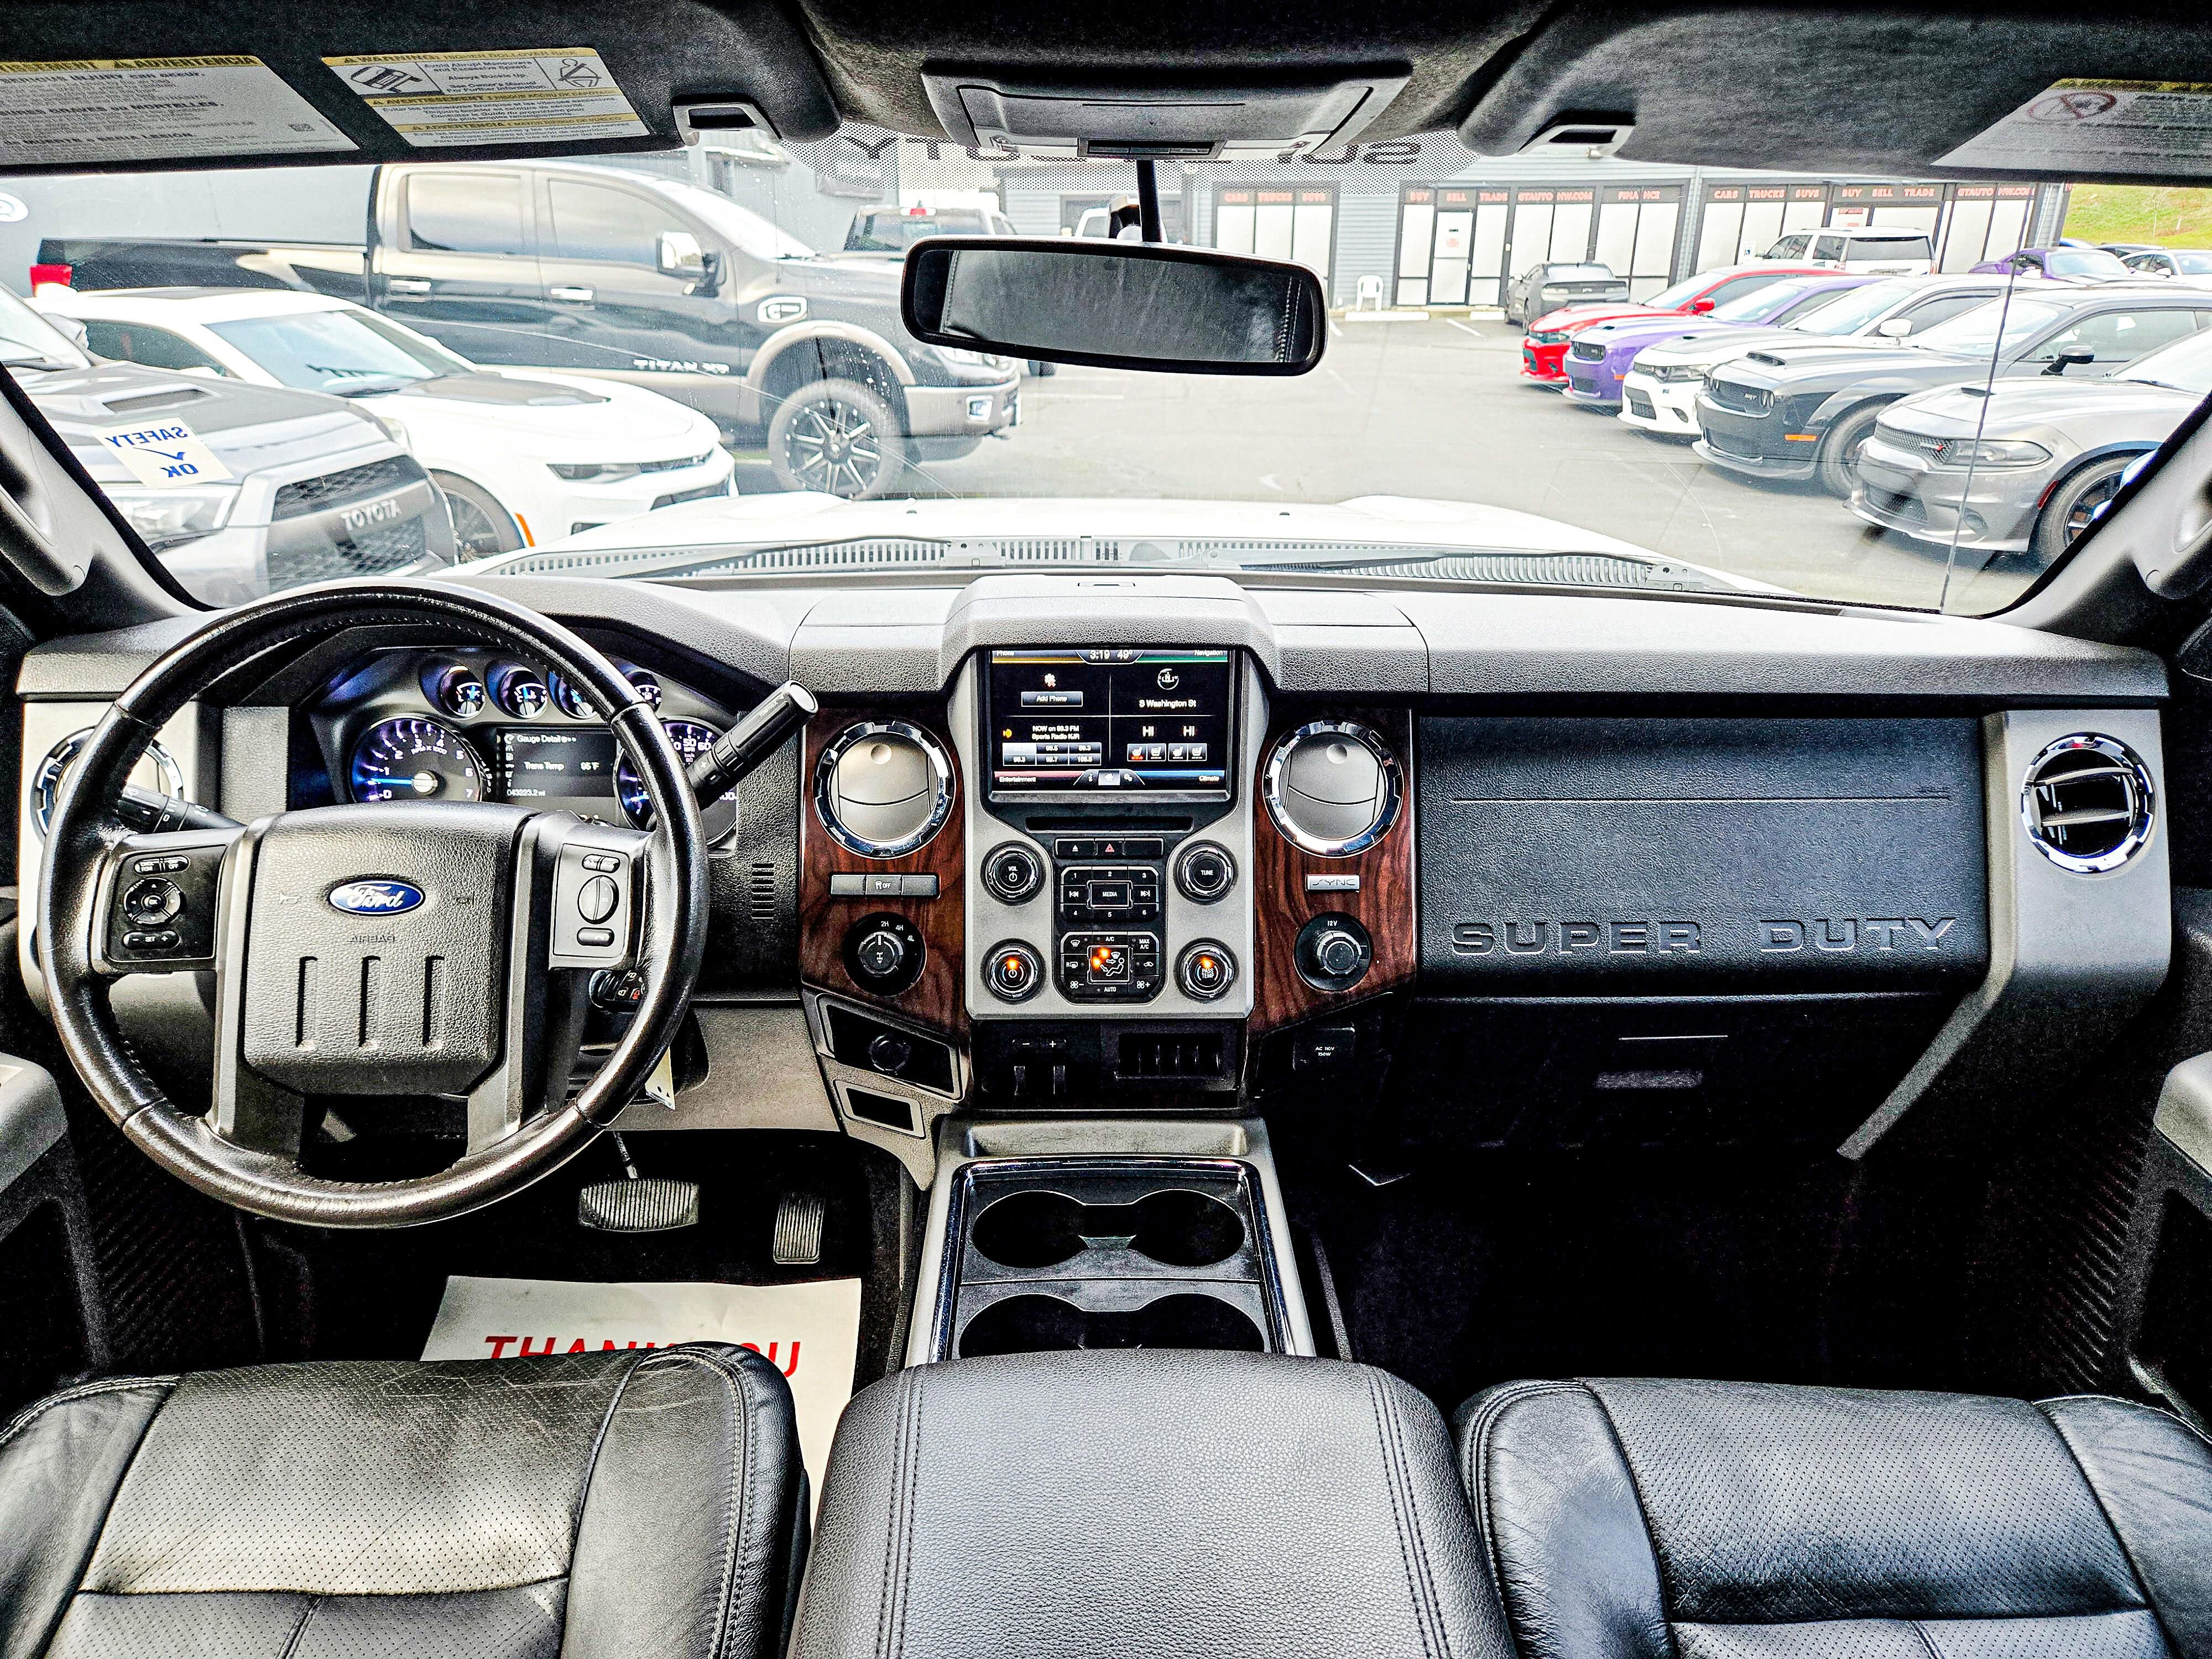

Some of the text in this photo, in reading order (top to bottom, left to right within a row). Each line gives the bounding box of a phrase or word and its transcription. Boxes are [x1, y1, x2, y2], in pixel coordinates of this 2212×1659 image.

[1410, 191, 1430, 201] BUY
[1446, 192, 1467, 202] SELL
[1479, 191, 1509, 202] TRADE
[1714, 190, 1738, 199] CARS
[1749, 189, 1786, 199] TRUCKS
[1795, 189, 1820, 198] SUVS
[1841, 188, 1863, 197] BUY
[1871, 188, 1893, 197] SELL
[1904, 188, 1935, 197] TRADE
[633, 359, 698, 372] TITAN
[340, 499, 403, 531] TOYOTA
[1089, 649, 1110, 660] 3:19
[1139, 699, 1197, 709] S Washington St
[1142, 726, 1155, 737] HI
[1183, 726, 1195, 737] HI
[517, 734, 541, 744] Gauge
[683, 738, 697, 747] 50
[697, 742, 712, 751] 60
[394, 750, 404, 760] 2
[456, 750, 465, 760] 5
[524, 761, 544, 770] Trans
[544, 761, 565, 771] Temp
[465, 767, 474, 777] 6
[465, 789, 473, 799] 7
[346, 884, 405, 908] Ford
[1451, 917, 1957, 955] SUPER DUTY
